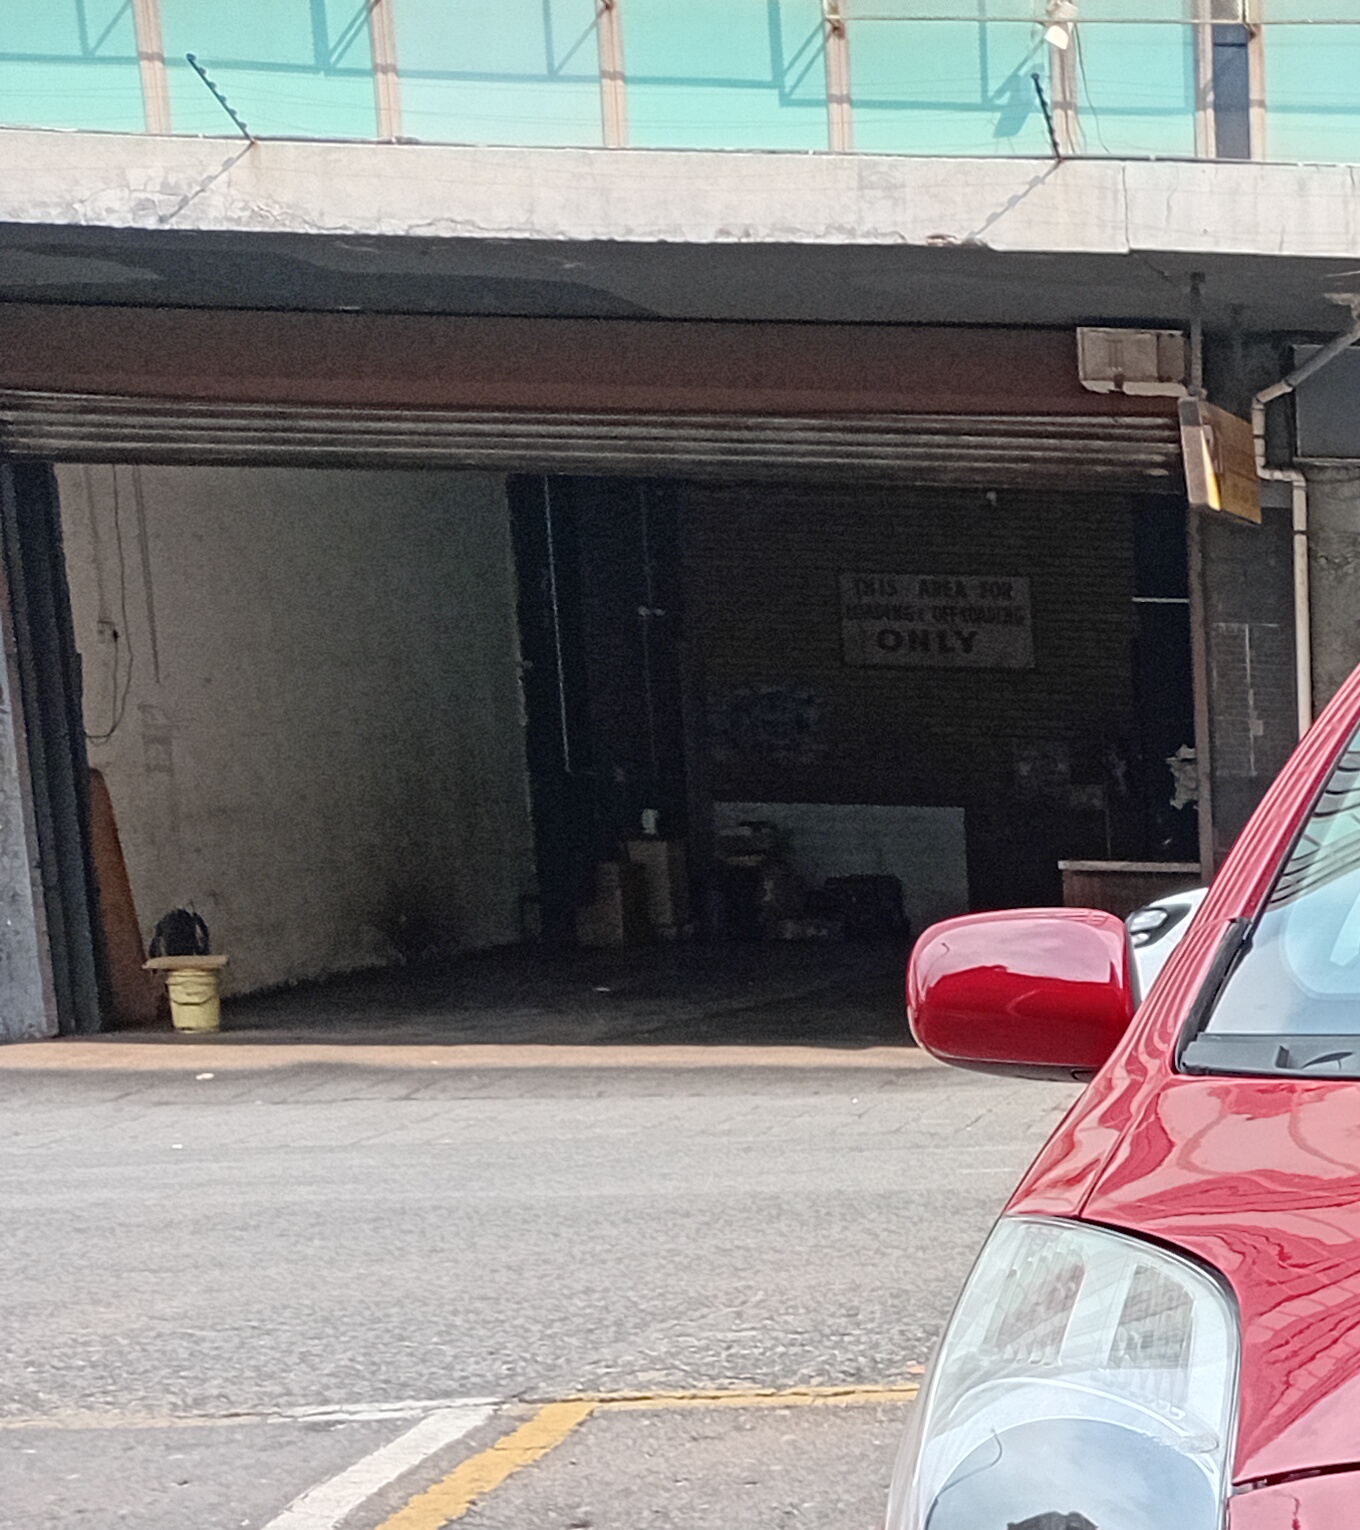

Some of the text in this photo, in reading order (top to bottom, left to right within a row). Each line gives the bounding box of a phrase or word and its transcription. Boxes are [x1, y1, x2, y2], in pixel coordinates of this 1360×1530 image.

[855, 577, 898, 598] THIS
[918, 578, 968, 599] AREA
[876, 627, 978, 655] ONLY
